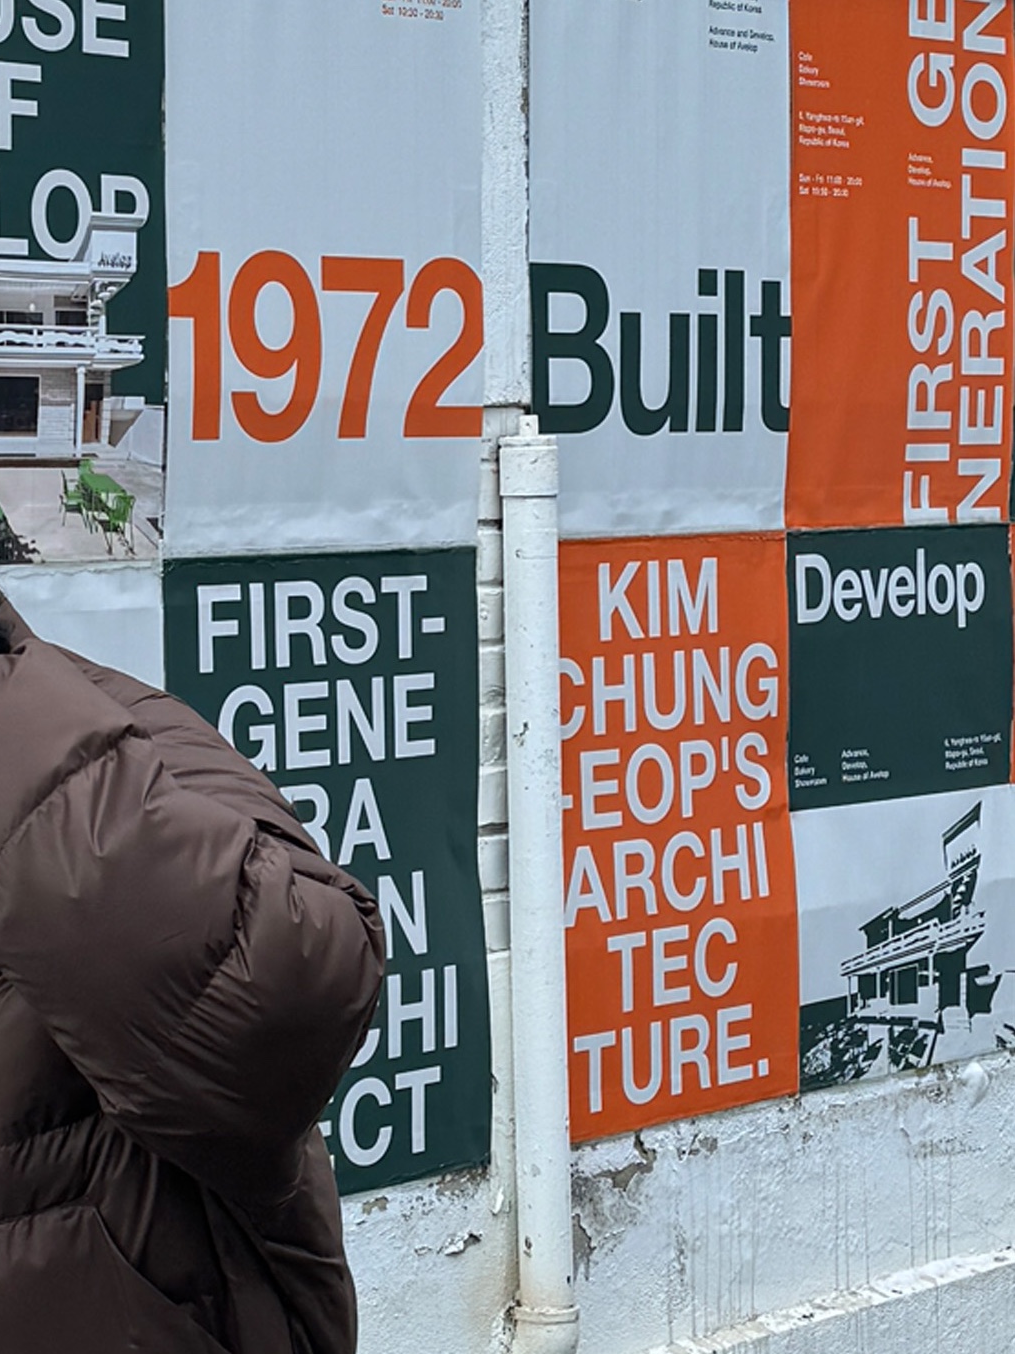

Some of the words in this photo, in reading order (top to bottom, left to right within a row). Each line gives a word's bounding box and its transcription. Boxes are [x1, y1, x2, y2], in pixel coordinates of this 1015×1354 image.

[956, 0, 1008, 525] NERATION
[168, 249, 485, 444] 1972
[529, 261, 792, 437] Built
[903, 216, 955, 526] FIRST
[196, 574, 447, 675] FIRST-
[597, 556, 719, 642] KIM
[794, 547, 986, 629] Develop
[216, 671, 436, 773] GENE
[564, 821, 770, 929] ARCHI
[606, 916, 739, 1014] TEC
[573, 1002, 770, 1114] TURE.
